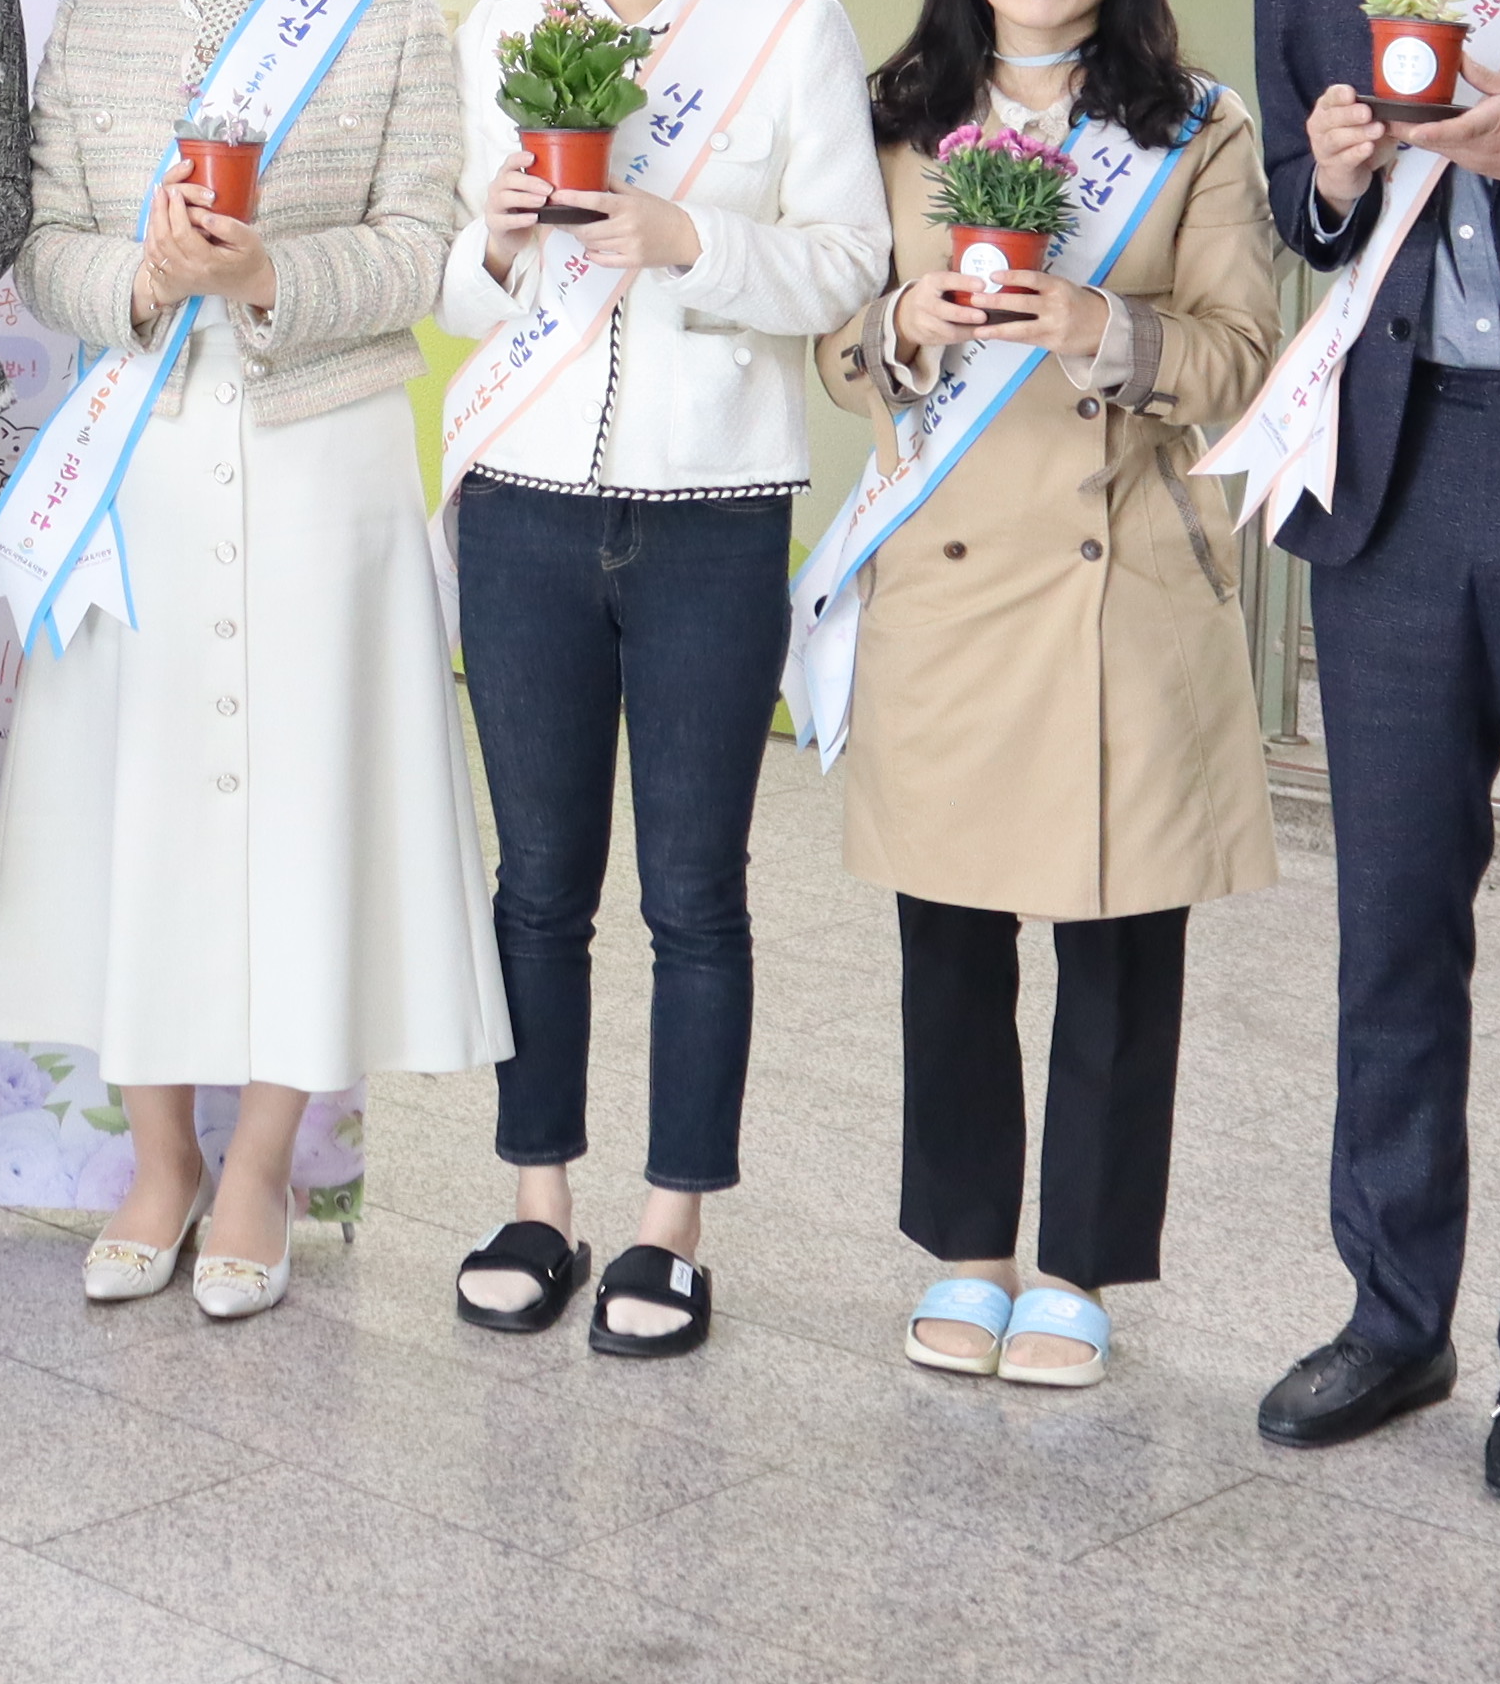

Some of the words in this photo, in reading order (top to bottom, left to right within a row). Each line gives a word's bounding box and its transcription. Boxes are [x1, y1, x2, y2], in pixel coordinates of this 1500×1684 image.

[648, 82, 705, 148] 사천
[1077, 145, 1133, 213] 사천
[30, 451, 81, 532] 꿈꾸다
